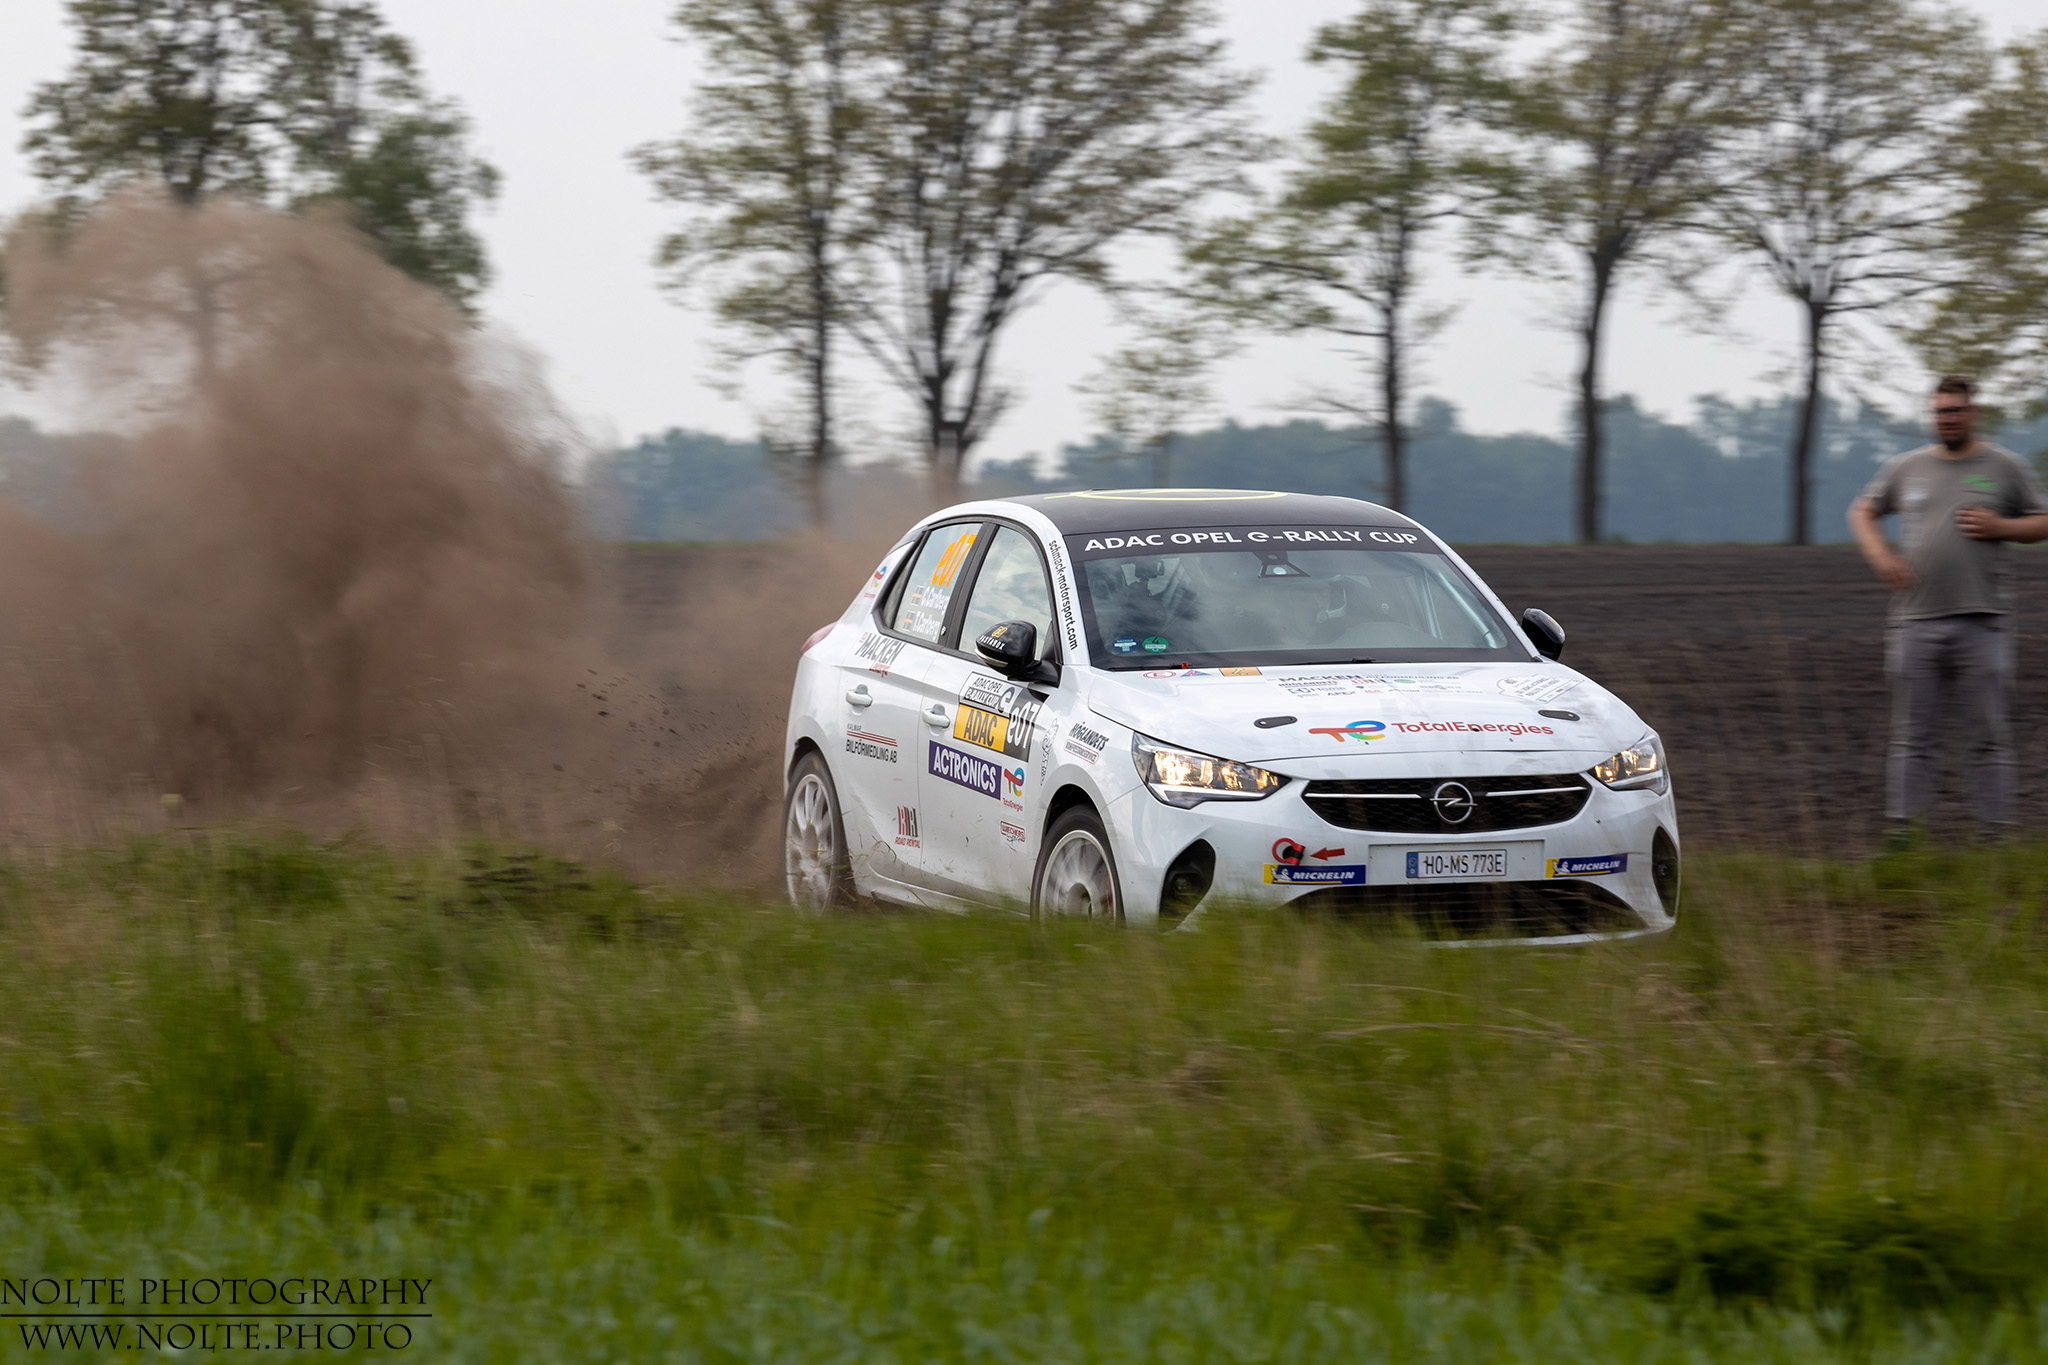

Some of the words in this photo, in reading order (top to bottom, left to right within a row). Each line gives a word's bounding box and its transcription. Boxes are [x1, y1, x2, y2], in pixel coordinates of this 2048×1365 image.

[1085, 535, 1164, 551] ADAC
[1170, 531, 1242, 545] OPEL
[1368, 531, 1419, 545] CUP
[931, 532, 977, 588] e07
[1048, 540, 1079, 651] schmack-motorsport.com
[854, 632, 907, 666] MACKEN
[1152, 637, 1160, 645] 4
[972, 677, 990, 690] ADAC
[987, 680, 1003, 694] OPEL
[963, 709, 998, 747] ADAC
[1006, 701, 1041, 749] e07
[1068, 721, 1110, 752] HÖGLANDETS
[1391, 721, 1554, 736] TotalEnergies
[846, 739, 889, 762] BILFÖRMEDLING
[889, 750, 898, 764] AB
[933, 746, 997, 793] ACTRONICS
[1425, 853, 1469, 874] HO-MS
[1472, 850, 1503, 873] 773E
[1570, 859, 1620, 872] MICHELIN
[1293, 871, 1355, 880] MICHELIN
